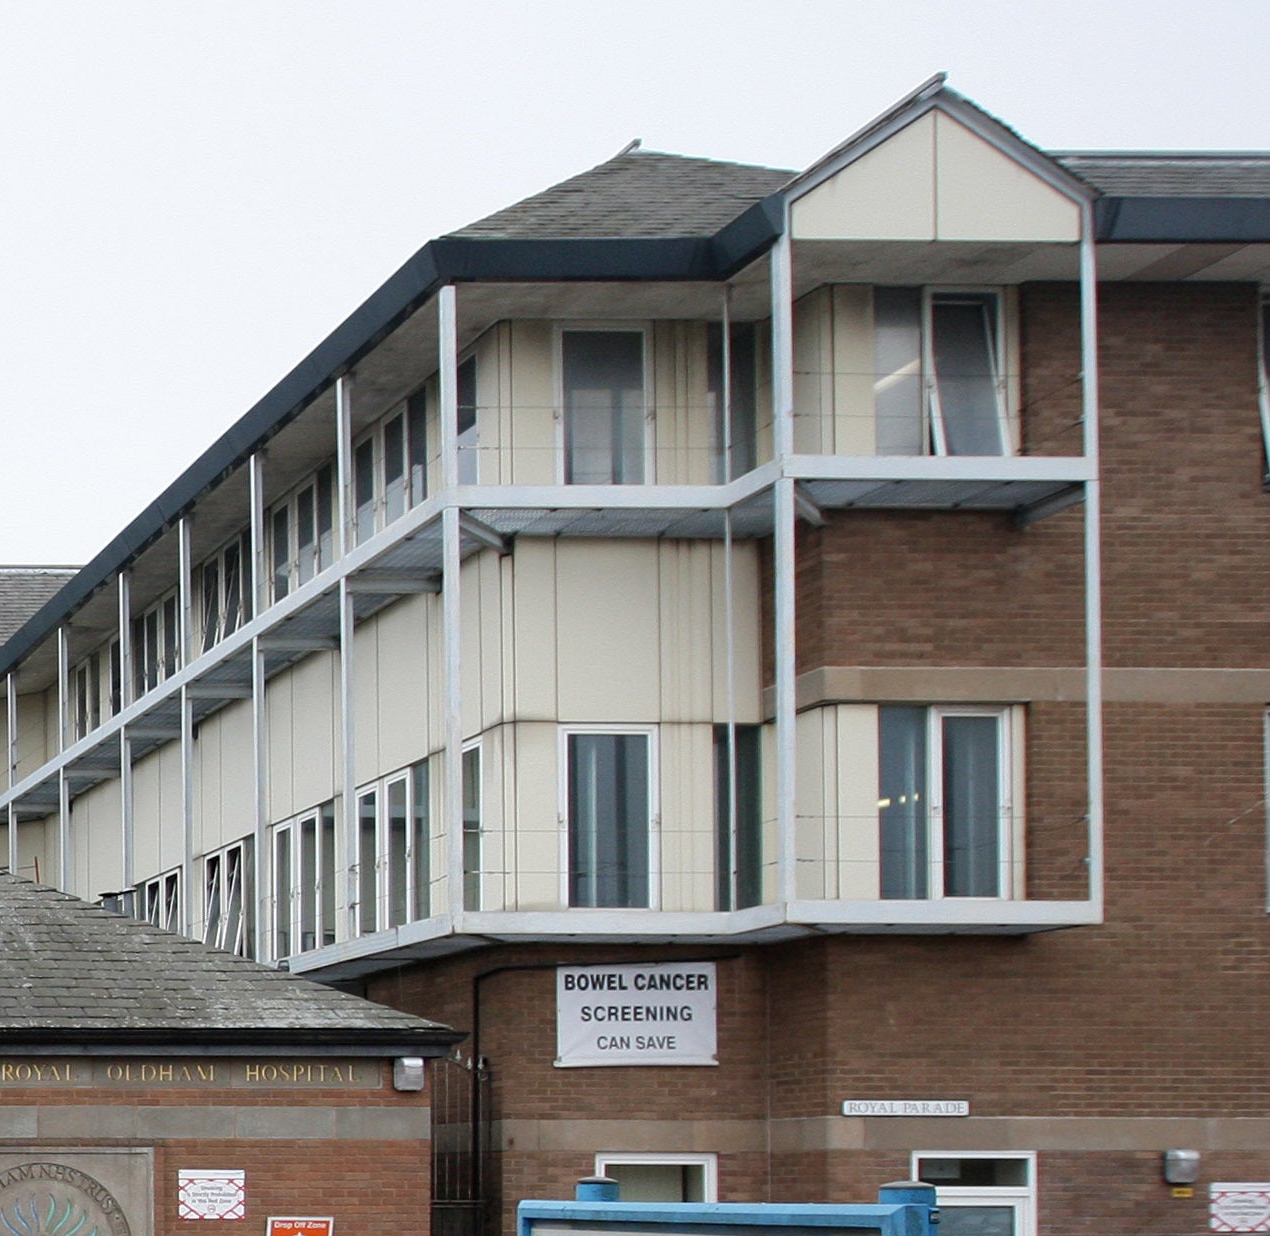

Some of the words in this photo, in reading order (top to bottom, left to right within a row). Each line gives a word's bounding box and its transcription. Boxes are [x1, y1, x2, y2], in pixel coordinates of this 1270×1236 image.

[564, 974, 628, 990] BOWEL
[634, 974, 709, 990] CANCER
[581, 1006, 693, 1022] SCREENING
[597, 1036, 630, 1050] CAN
[636, 1036, 676, 1050] SAVE
[1, 1064, 77, 1081] ROYAL
[107, 1064, 215, 1082] OLDHAM
[246, 1064, 362, 1082] HOSPITAL
[849, 1102, 897, 1113] ROYAL
[903, 1102, 965, 1113] PARADE
[39, 1165, 76, 1183] NHS
[75, 1174, 120, 1217] TRUST
[274, 1222, 293, 1230] Drop
